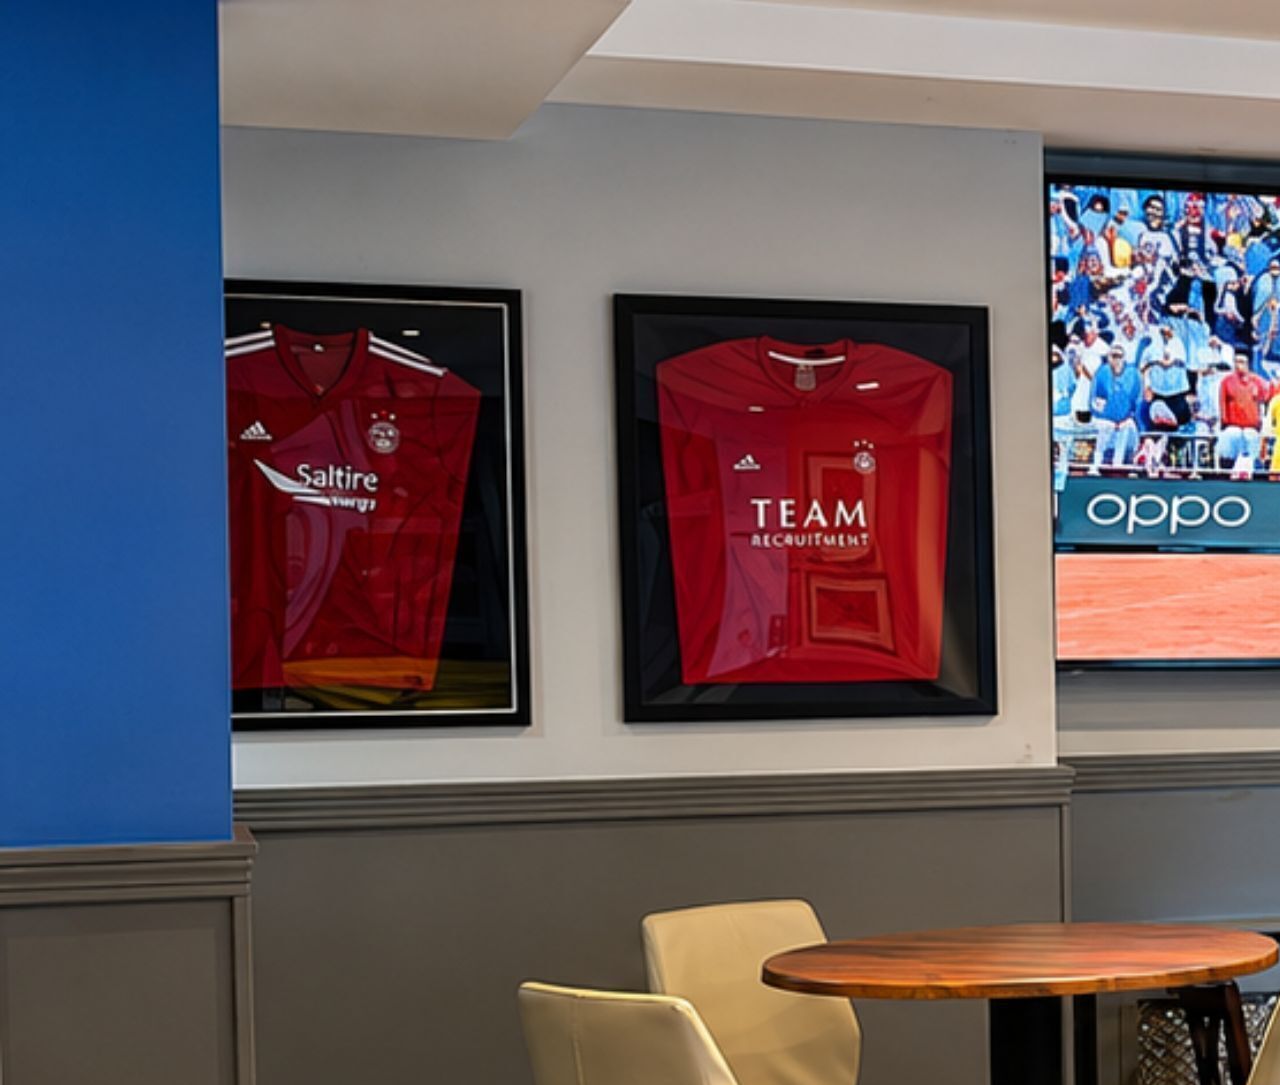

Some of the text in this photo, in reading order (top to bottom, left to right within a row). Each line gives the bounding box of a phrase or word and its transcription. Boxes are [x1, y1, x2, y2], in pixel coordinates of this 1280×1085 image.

[297, 463, 379, 492] Saltire
[750, 498, 868, 528] TEAM
[1087, 493, 1251, 534] oppo
